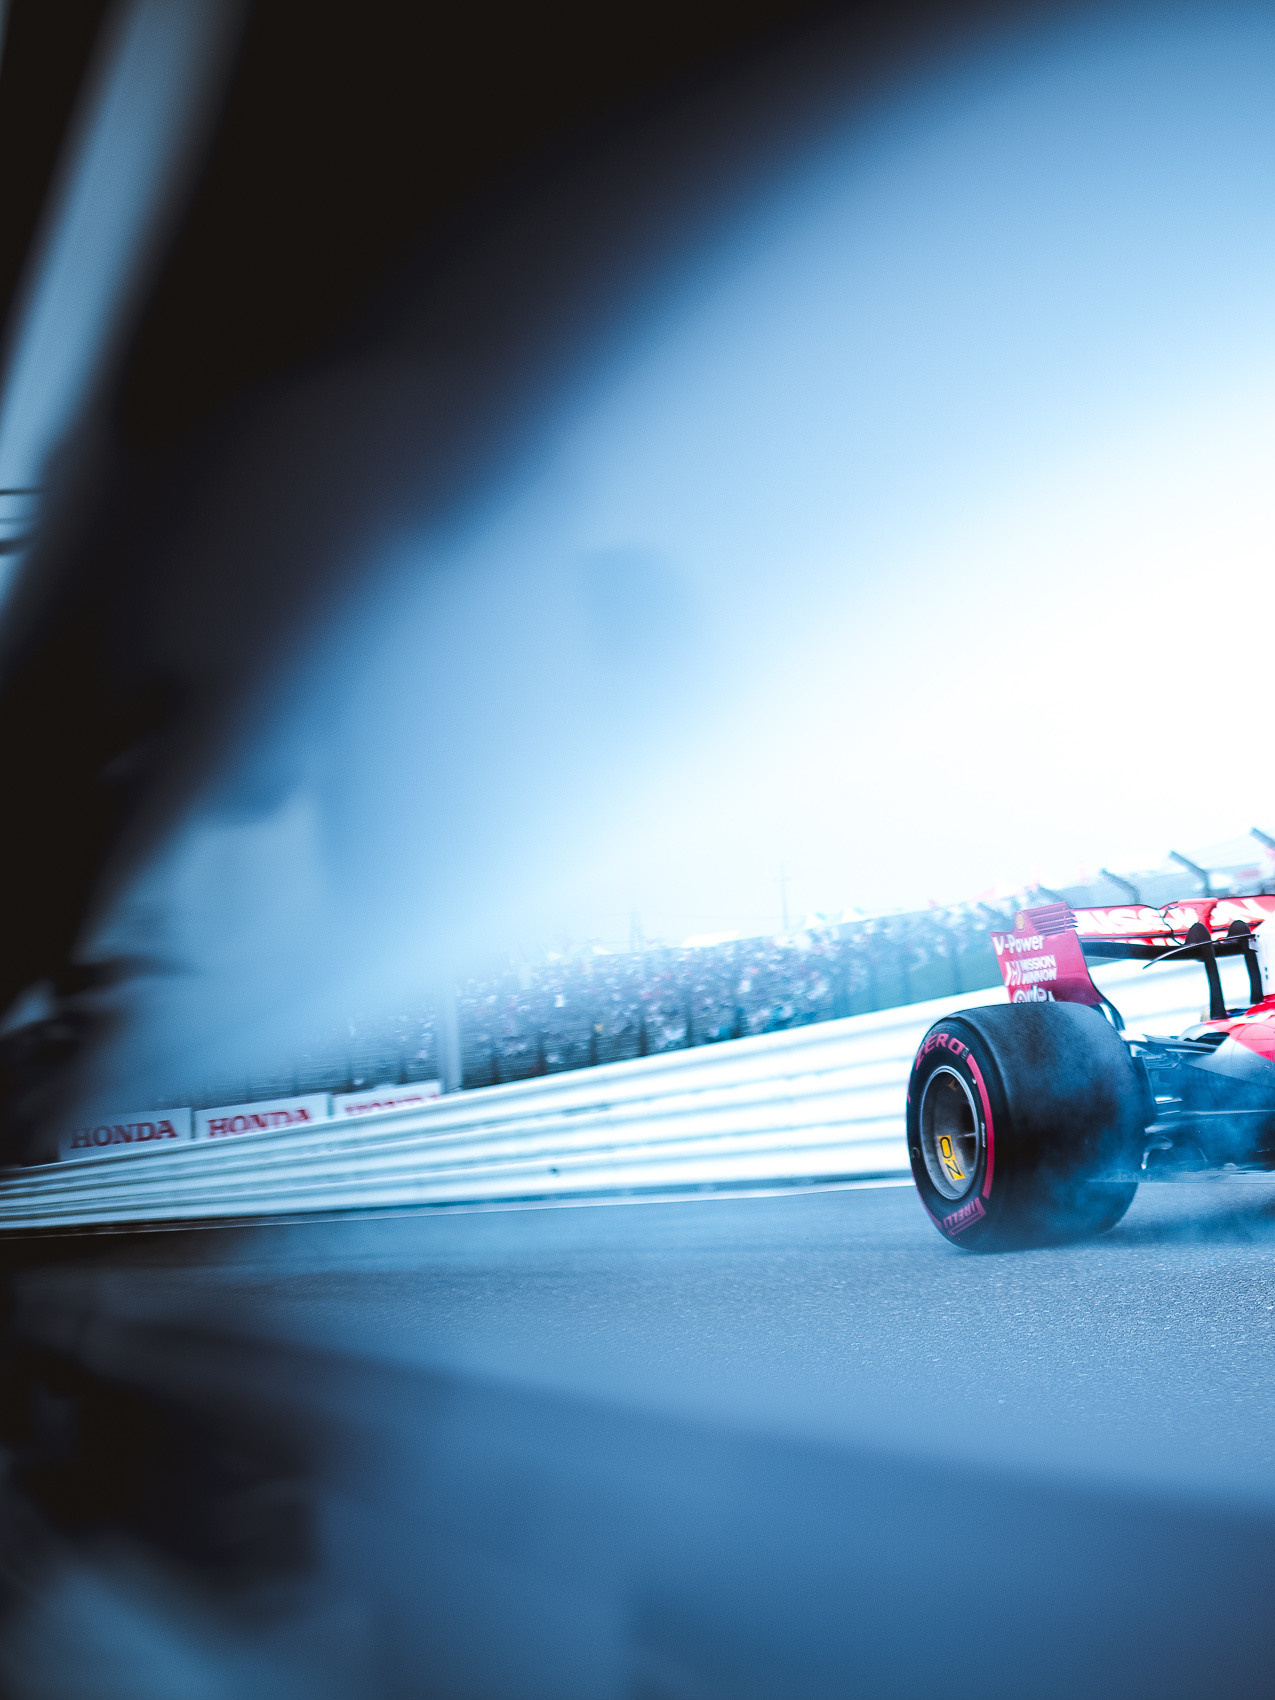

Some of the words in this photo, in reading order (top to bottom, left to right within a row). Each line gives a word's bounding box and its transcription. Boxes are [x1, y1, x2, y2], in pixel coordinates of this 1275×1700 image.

[992, 933, 1045, 956] V-Power
[70, 1119, 179, 1149] HONDA
[207, 1108, 312, 1138] HONDA
